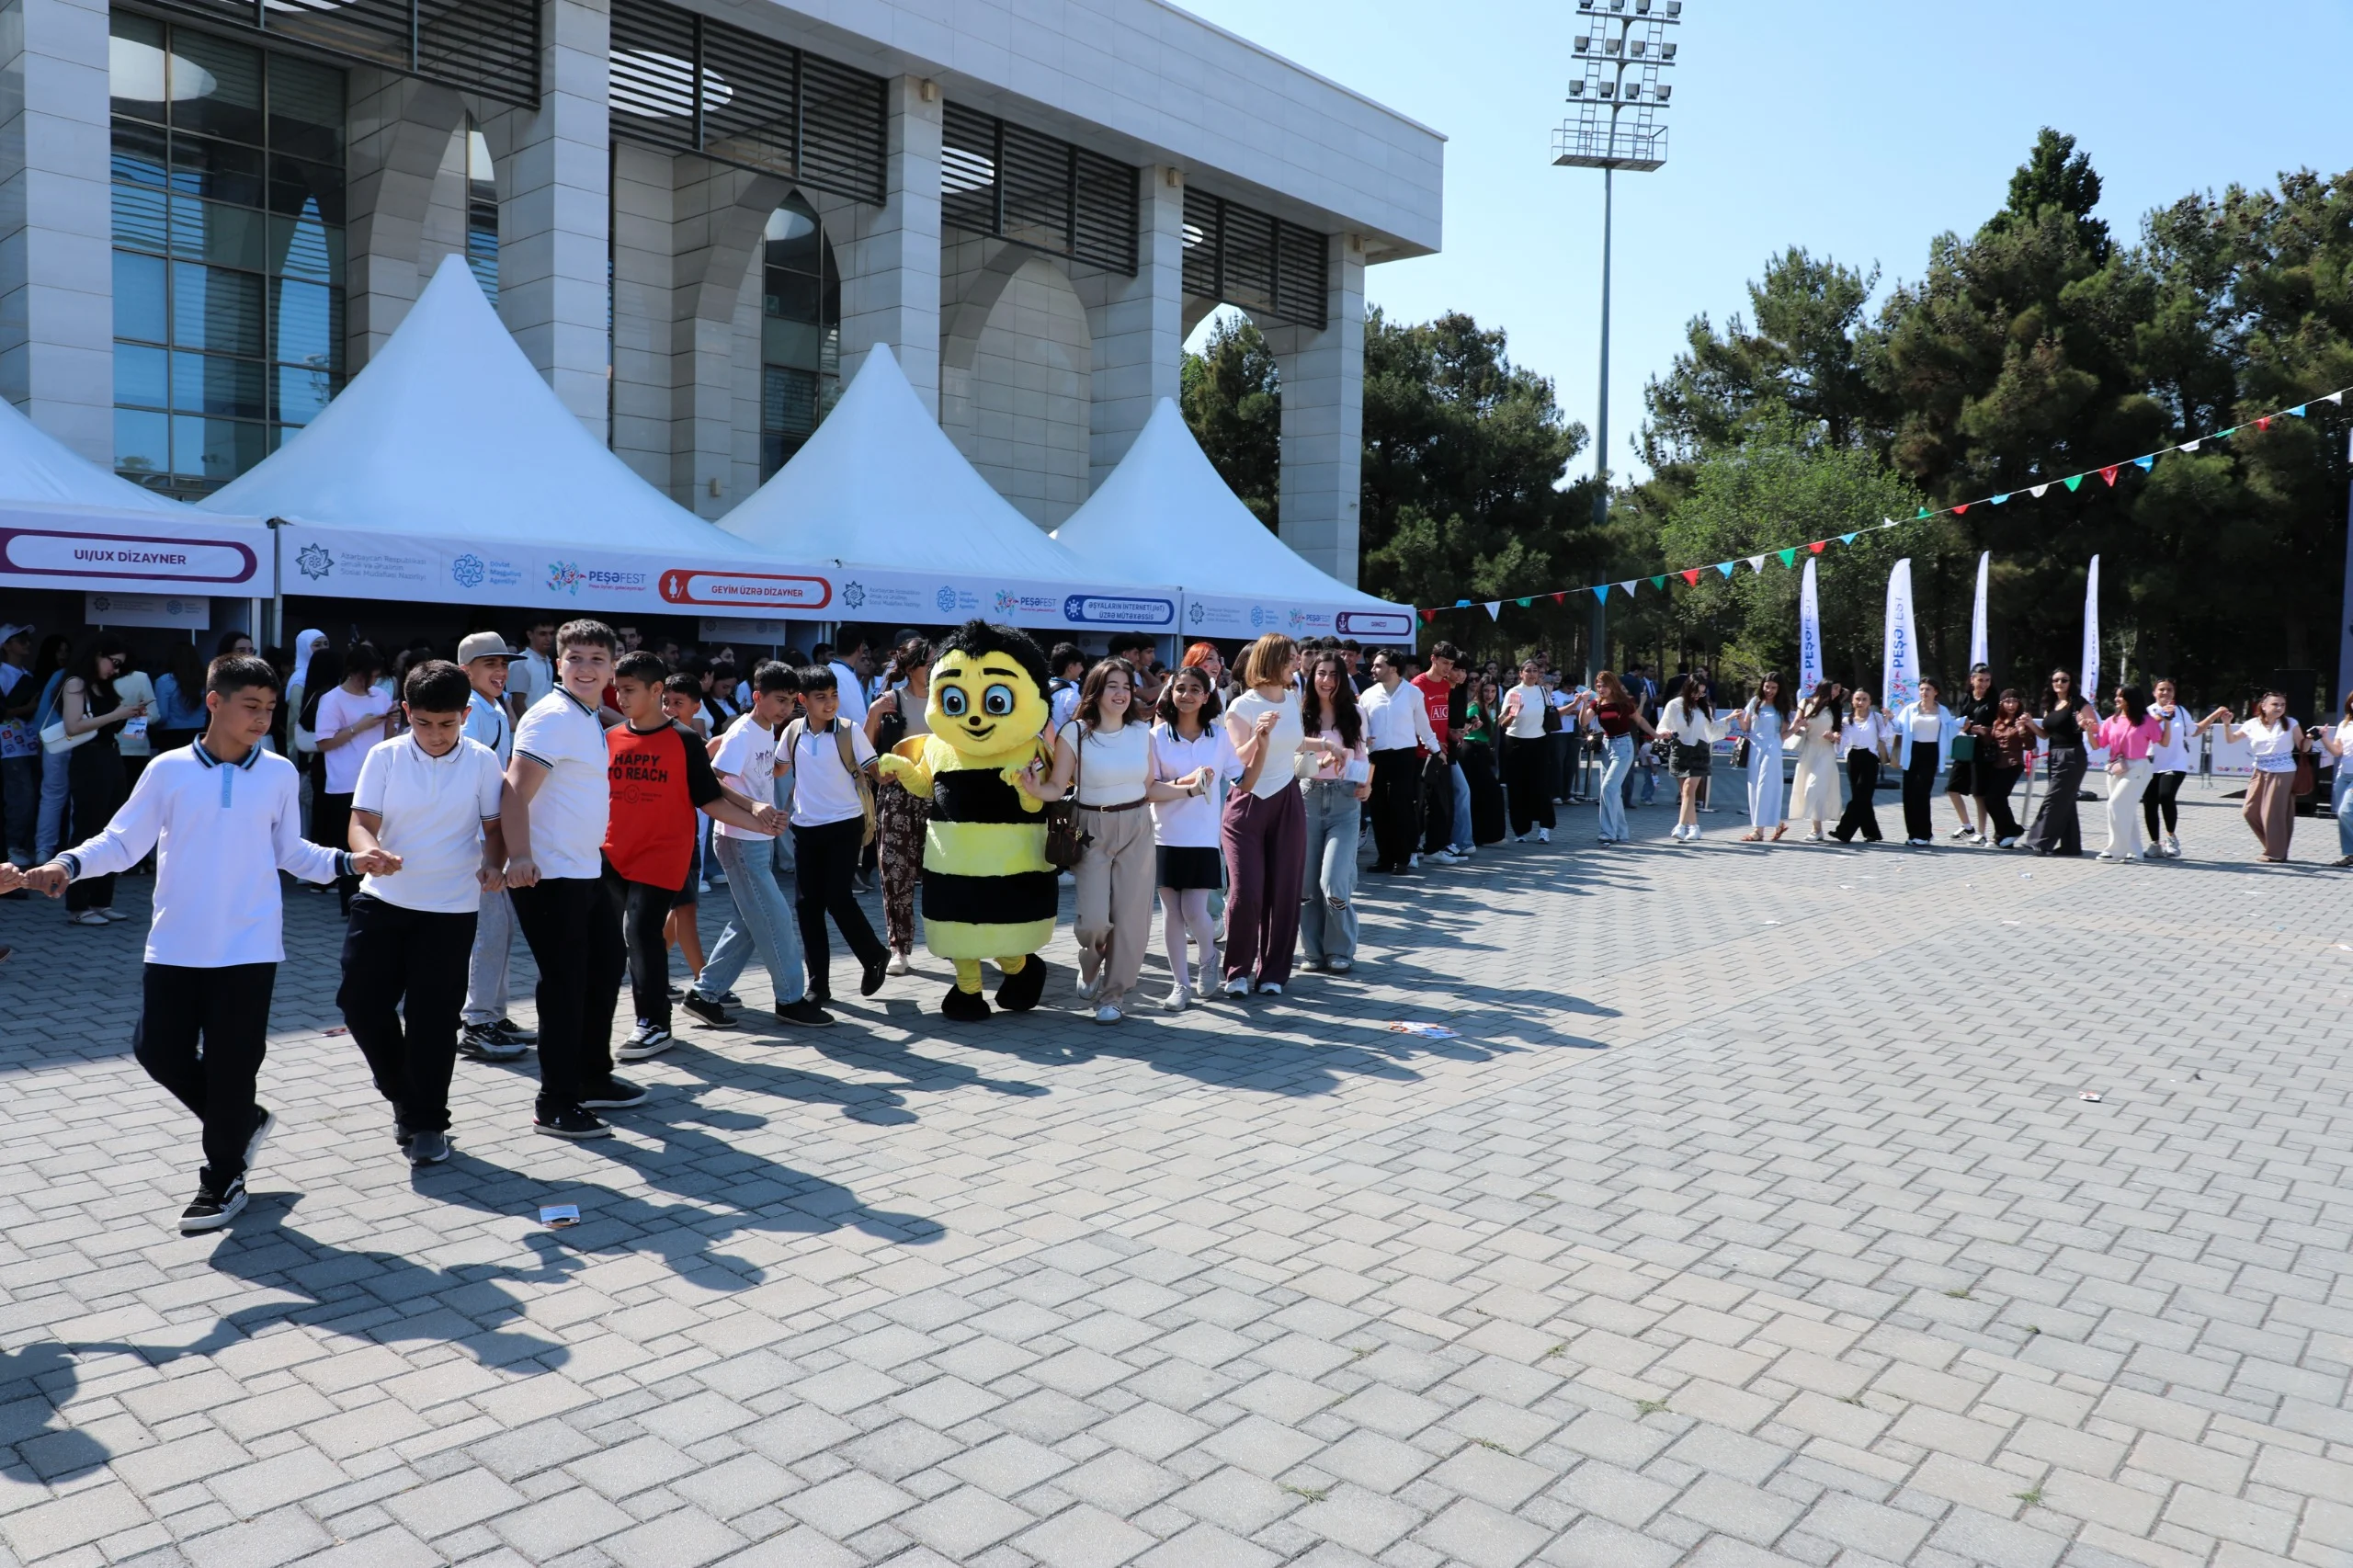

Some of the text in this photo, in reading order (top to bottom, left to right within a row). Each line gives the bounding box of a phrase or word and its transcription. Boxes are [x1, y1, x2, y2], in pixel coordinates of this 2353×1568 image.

[74, 549, 187, 565] UI/UX DİZAYNER
[588, 571, 646, 585] PEŞƏFEST
[711, 585, 803, 597] GEYİM ÜZRƏ DİZAYNER
[1020, 597, 1057, 608] PEŞƏFEST
[1099, 610, 1116, 619] ÜZRƏ
[1893, 597, 1908, 668] PEŞƏFEST
[614, 754, 661, 767] HAPPY
[626, 767, 668, 783] REACH
